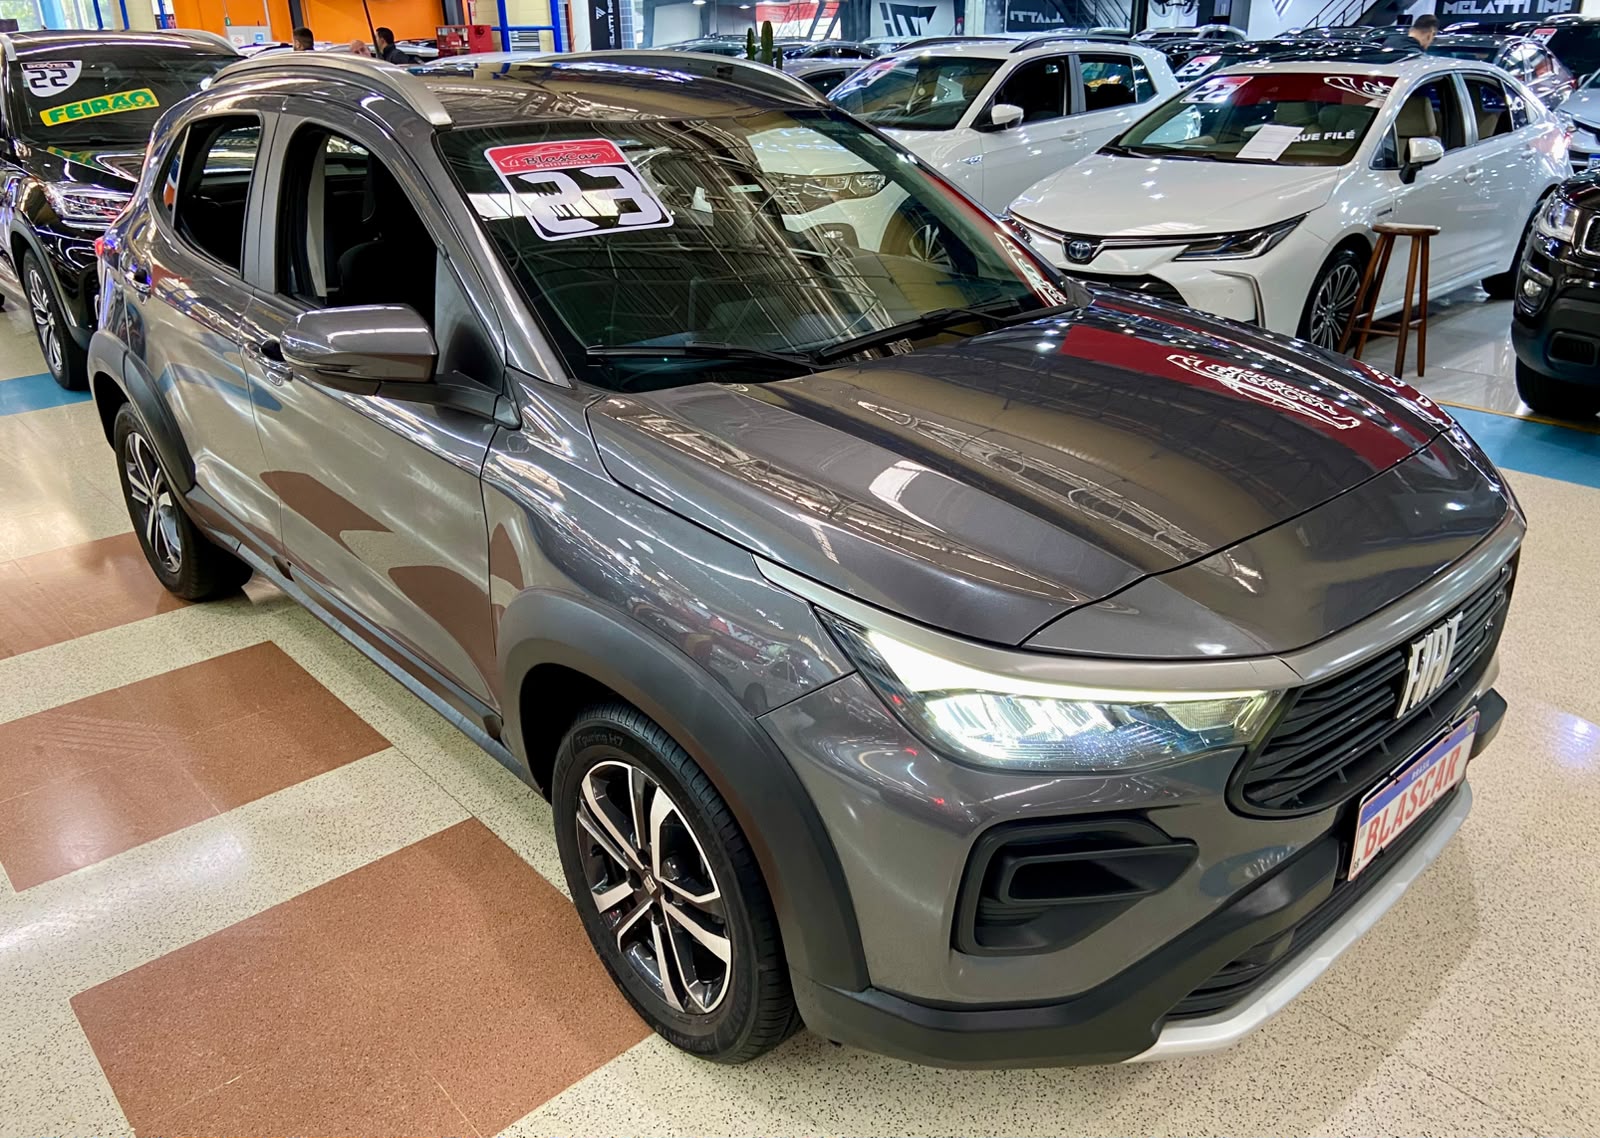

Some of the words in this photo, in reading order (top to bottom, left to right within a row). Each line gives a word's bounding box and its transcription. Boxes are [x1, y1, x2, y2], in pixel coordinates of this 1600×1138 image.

[28, 69, 69, 88] 22
[48, 89, 156, 123] FEIRÃO
[1323, 129, 1356, 140] FILÉ
[522, 152, 601, 166] BlasCar
[517, 166, 663, 233] 23
[1396, 611, 1464, 719] FIAT
[1363, 745, 1463, 861] BLASCAR
